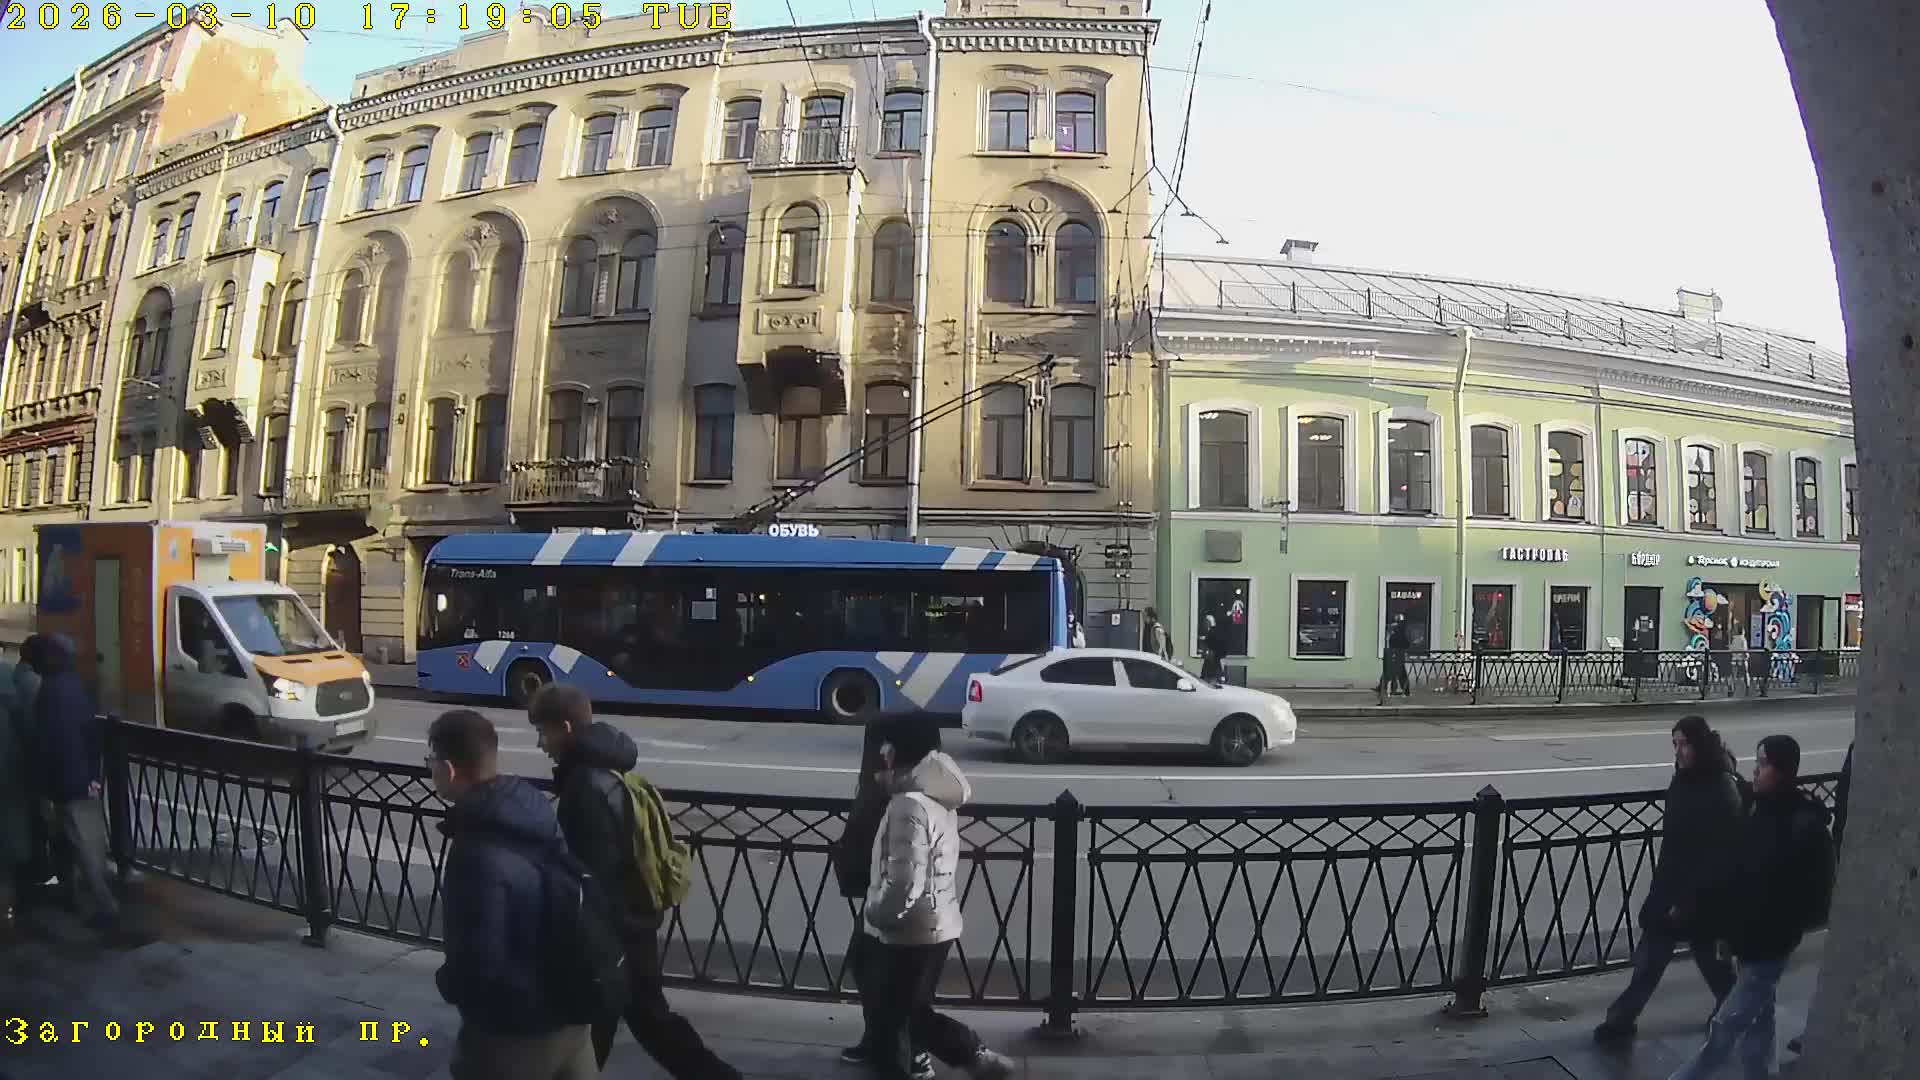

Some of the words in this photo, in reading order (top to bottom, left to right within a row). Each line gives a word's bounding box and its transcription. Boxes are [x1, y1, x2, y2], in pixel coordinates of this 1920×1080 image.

[768, 523, 819, 537] ОБУВЬ
[1502, 547, 1569, 562] ГАСТРОПАБ
[450, 568, 497, 579] Trans-Alfa
